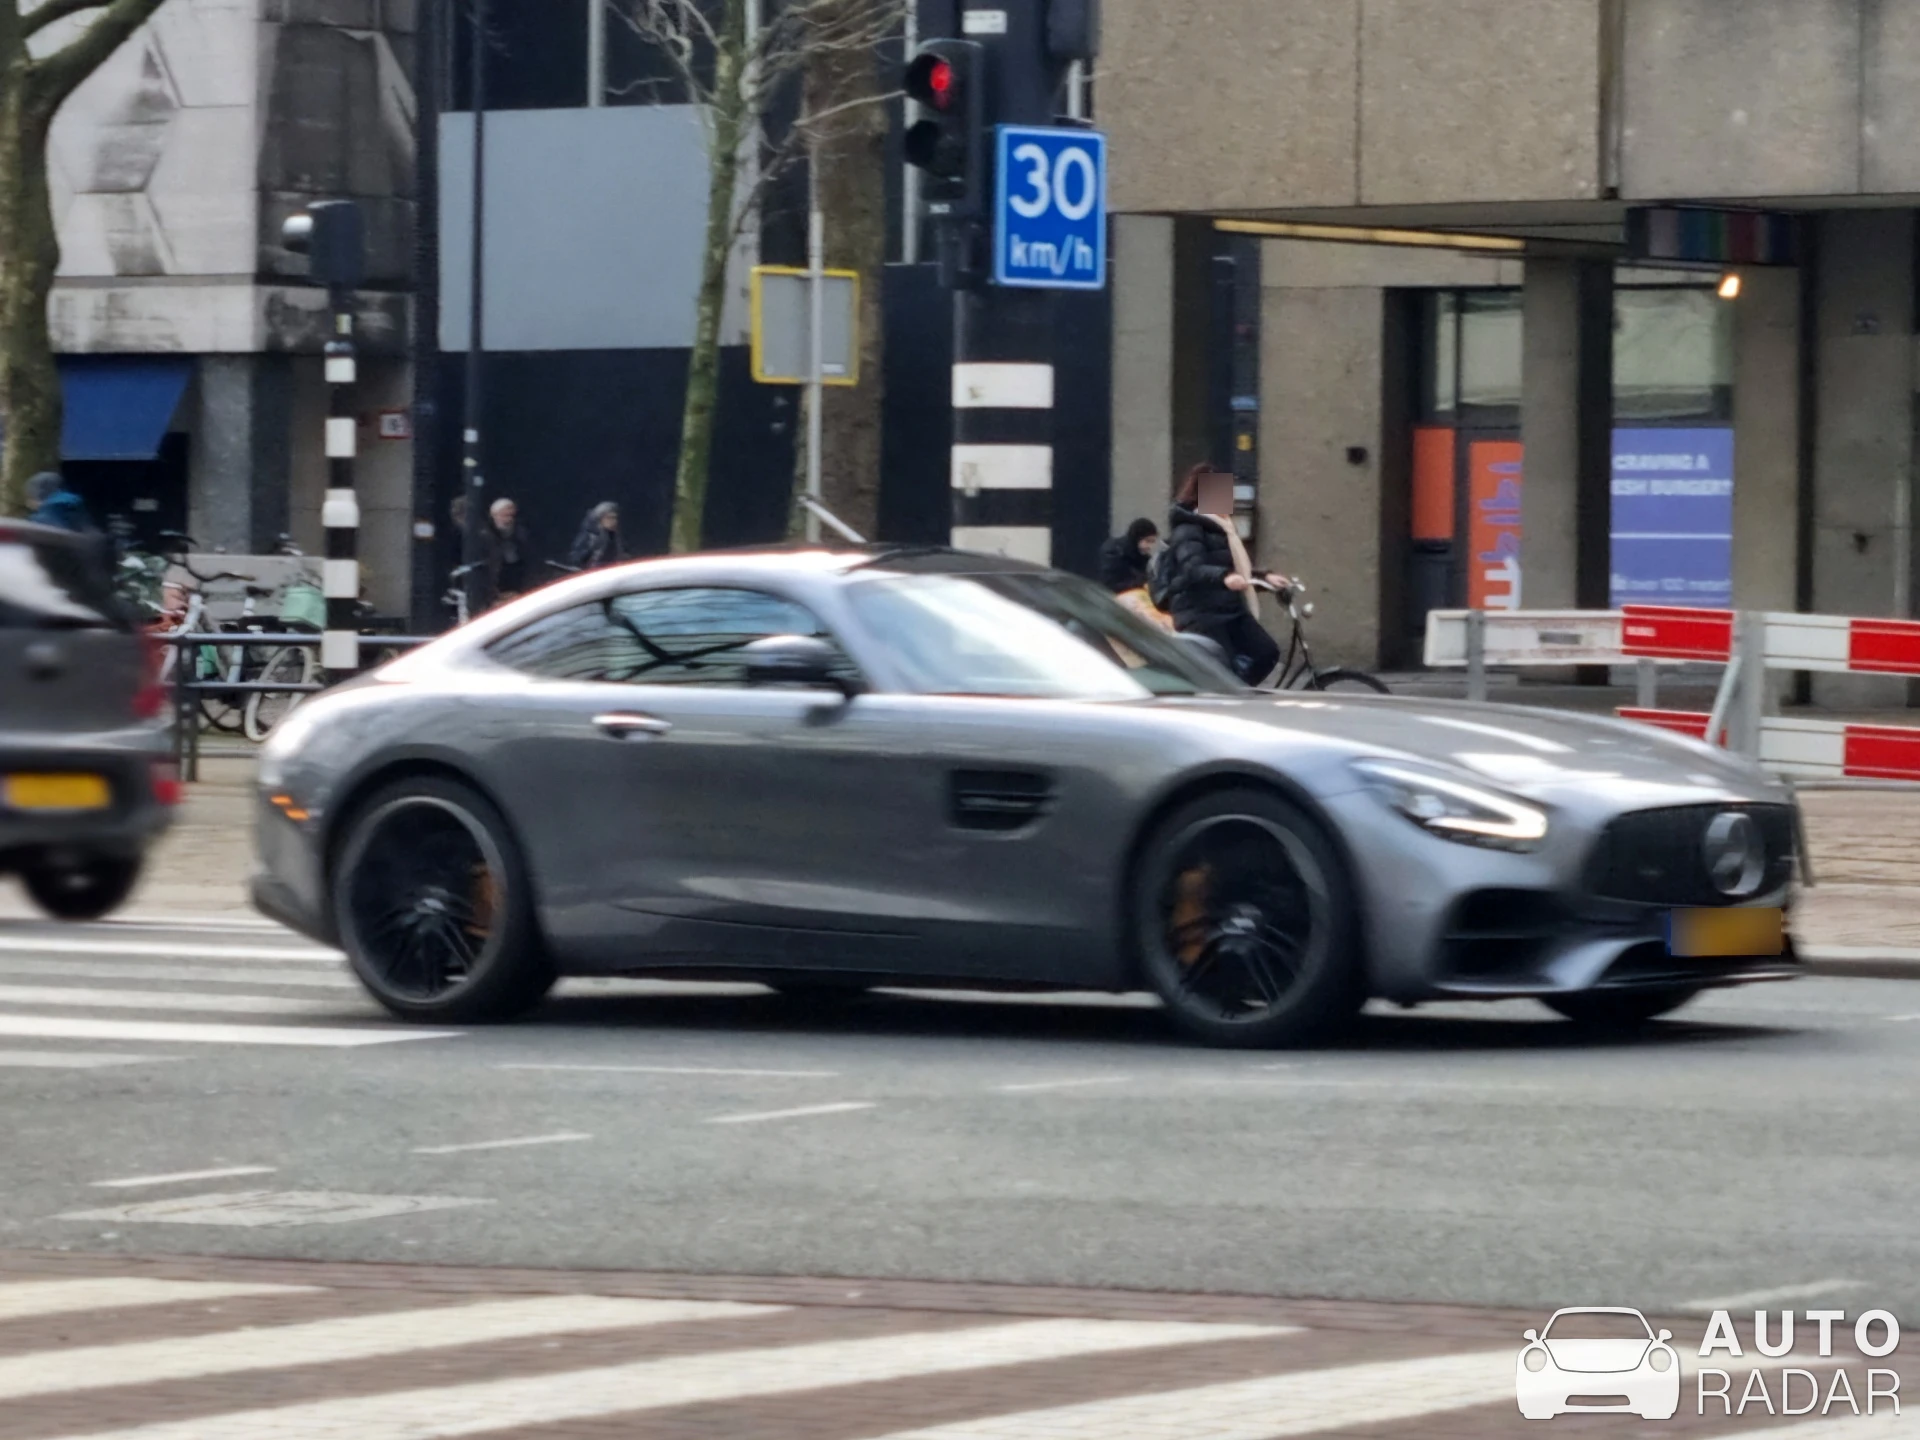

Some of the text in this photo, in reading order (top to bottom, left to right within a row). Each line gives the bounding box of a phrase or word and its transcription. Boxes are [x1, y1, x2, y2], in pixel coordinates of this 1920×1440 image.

[1009, 143, 1096, 221] 30
[1010, 233, 1093, 275] km/h
[1695, 454, 1709, 470] A
